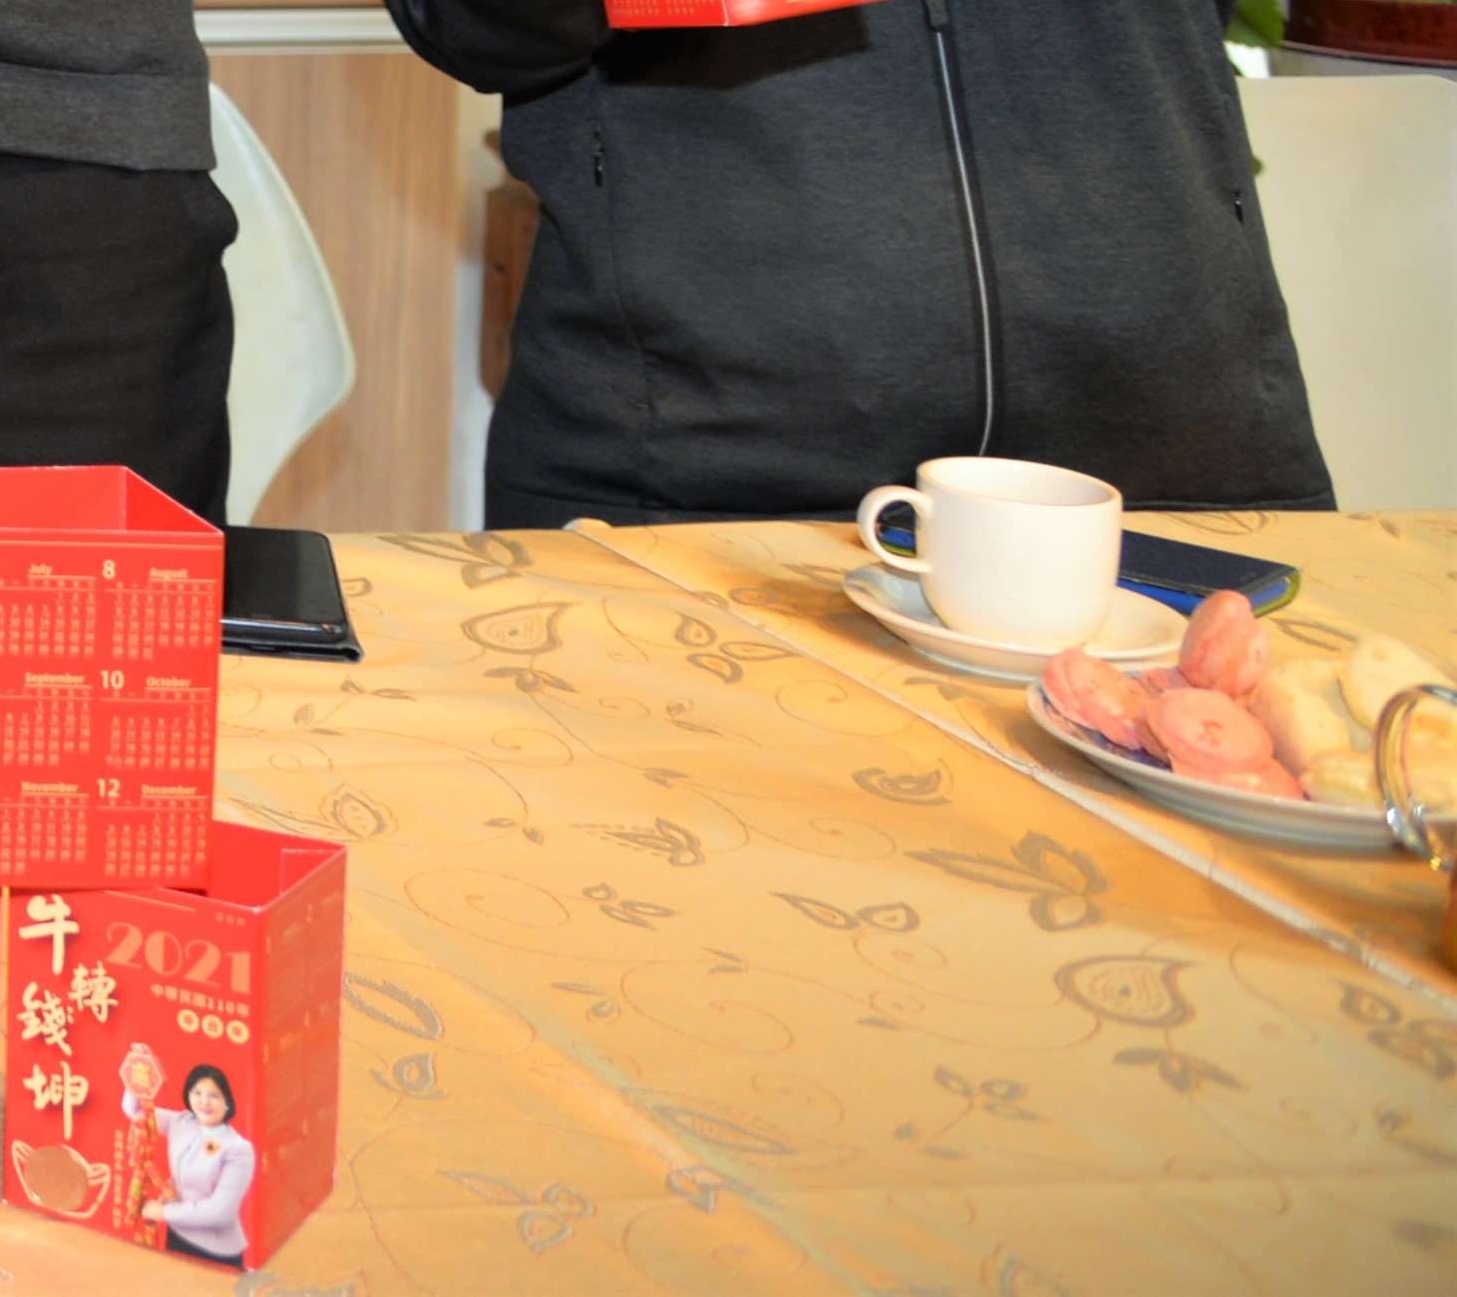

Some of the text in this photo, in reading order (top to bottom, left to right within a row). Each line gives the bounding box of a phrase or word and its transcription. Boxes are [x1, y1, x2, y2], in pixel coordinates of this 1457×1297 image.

[103, 559, 116, 580] 8
[100, 670, 125, 689] 10
[97, 778, 120, 798] 12
[105, 921, 252, 996] 2021
